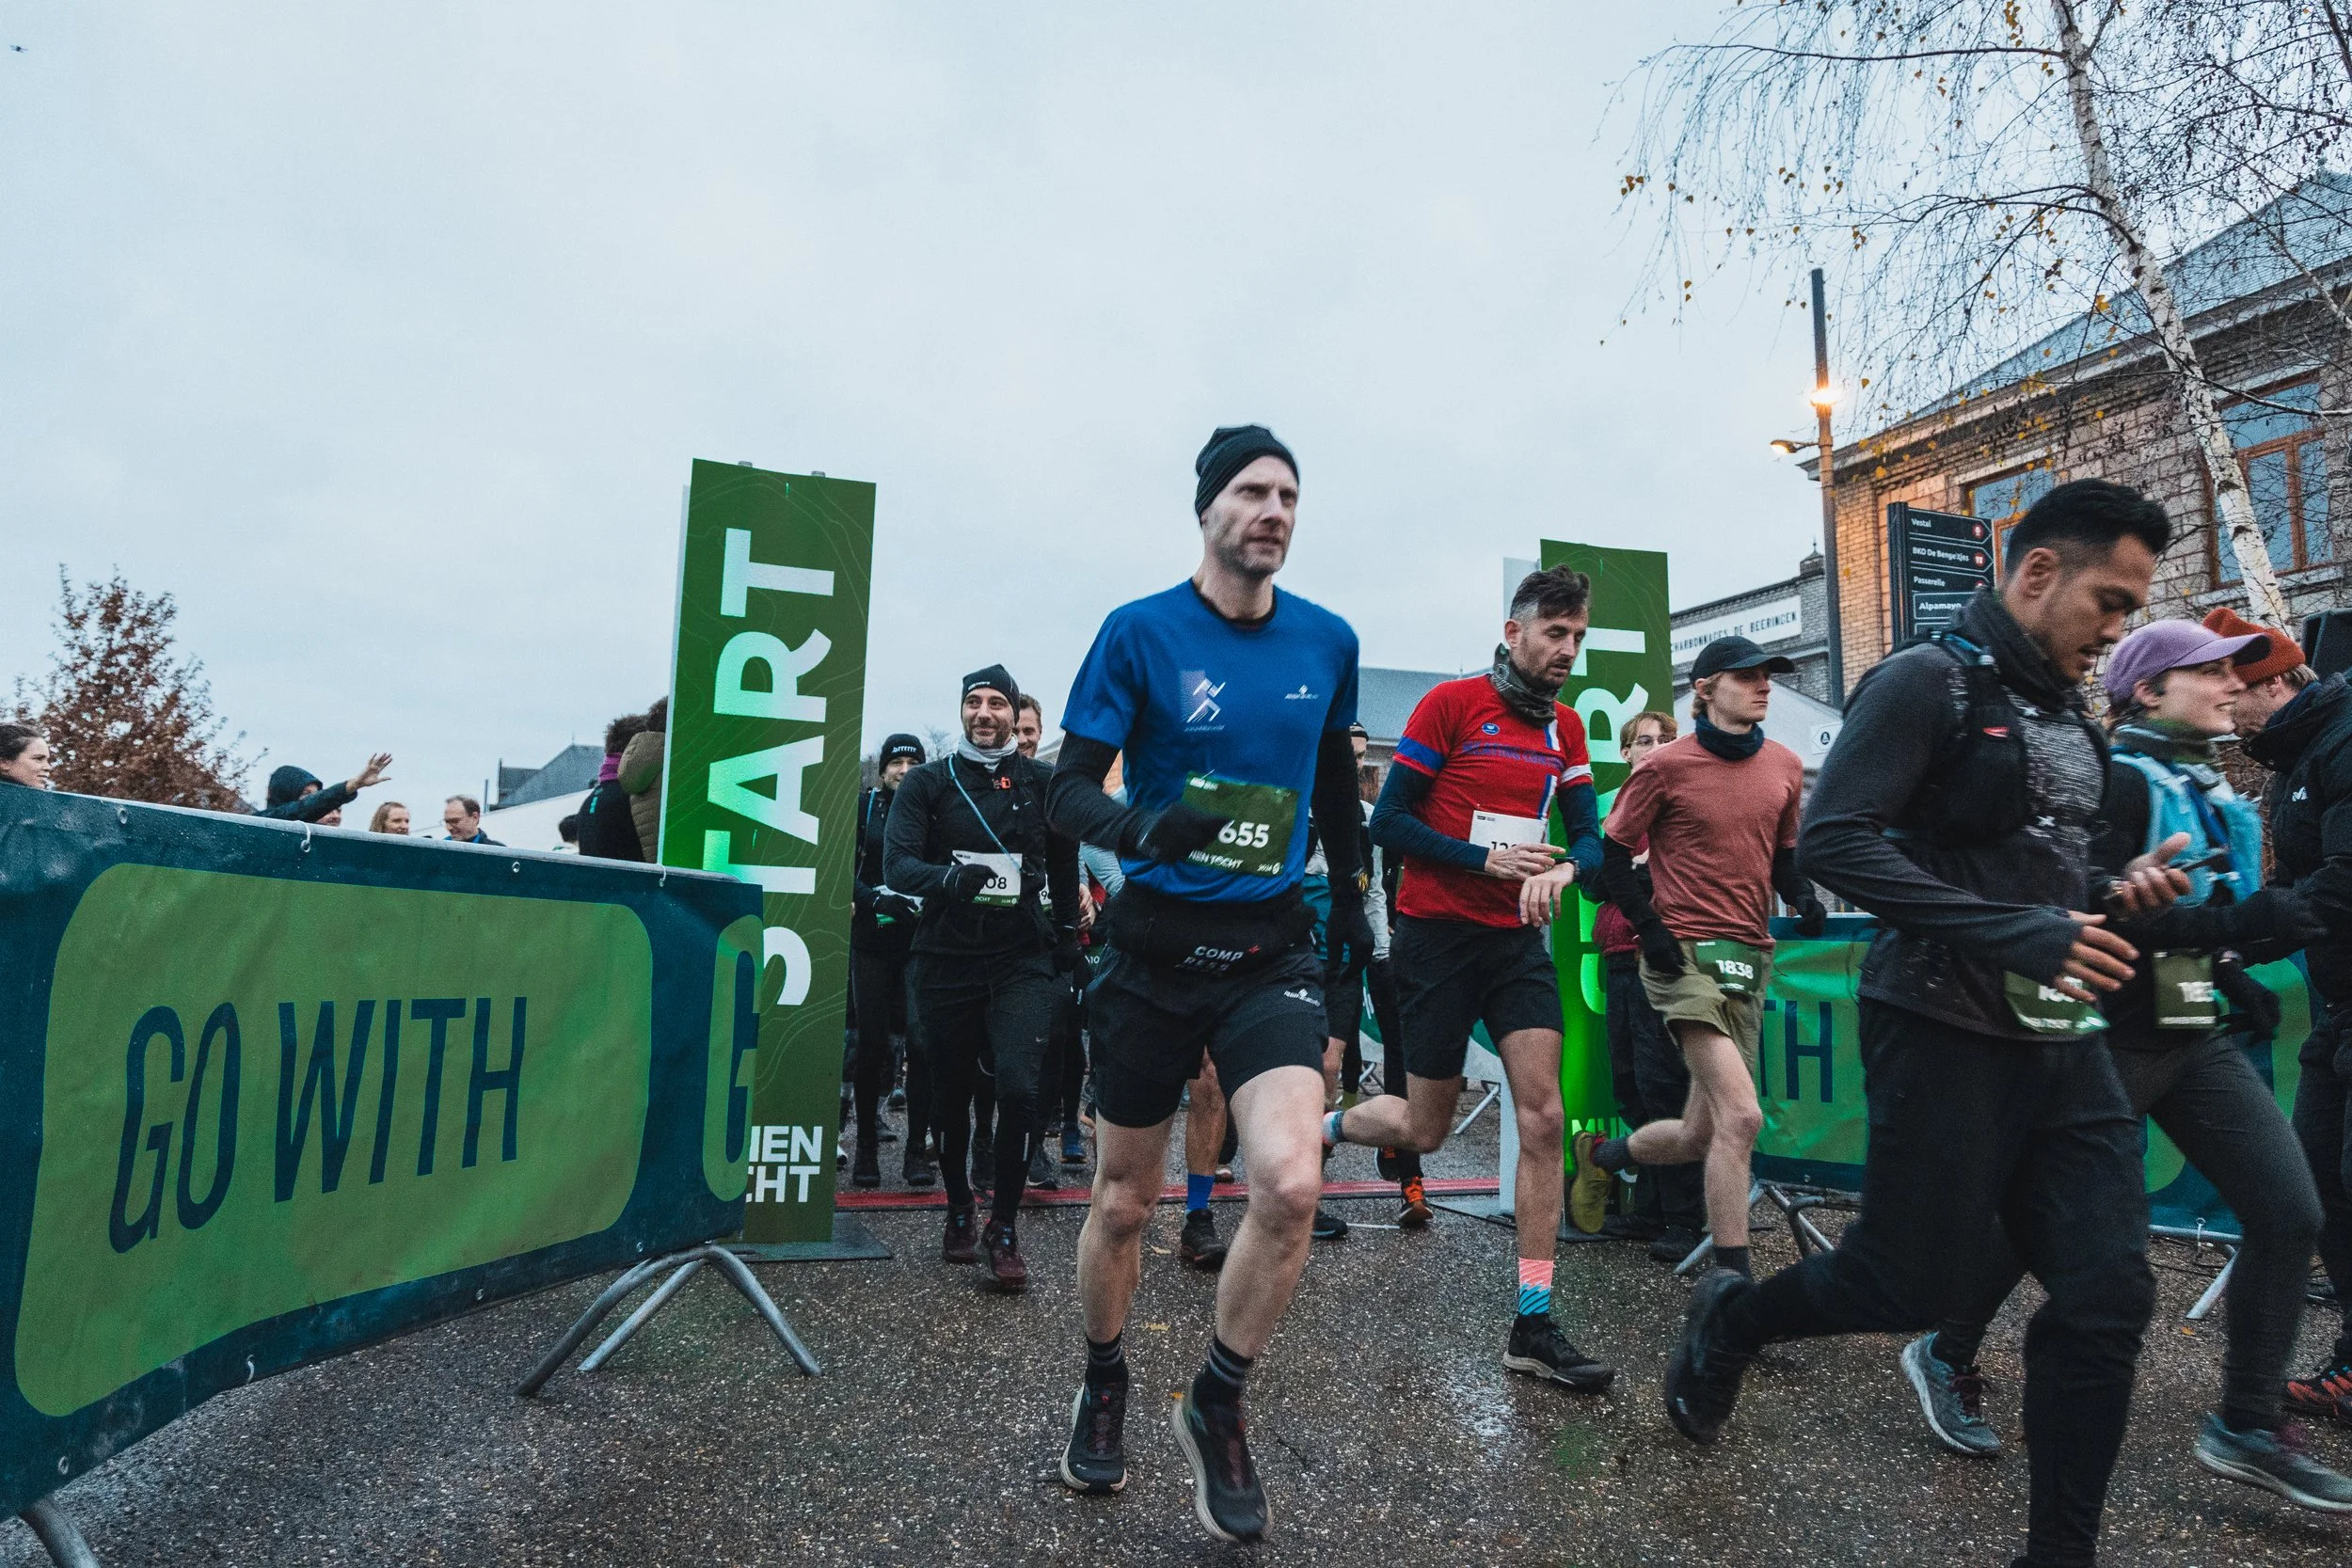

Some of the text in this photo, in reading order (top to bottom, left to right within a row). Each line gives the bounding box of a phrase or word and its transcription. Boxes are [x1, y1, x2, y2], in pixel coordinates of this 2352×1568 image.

[1911, 518, 1931, 528] Vestal
[1914, 576, 1947, 587] Passerelle
[1918, 602, 1963, 611] Alpamayo
[1734, 625, 1743, 637] DE
[1217, 820, 1270, 848] 655
[1194, 945, 1245, 962] COMP
[1715, 959, 1755, 980] 1838
[108, 997, 527, 1255] GO WITH
[746, 1165, 820, 1203] HT
